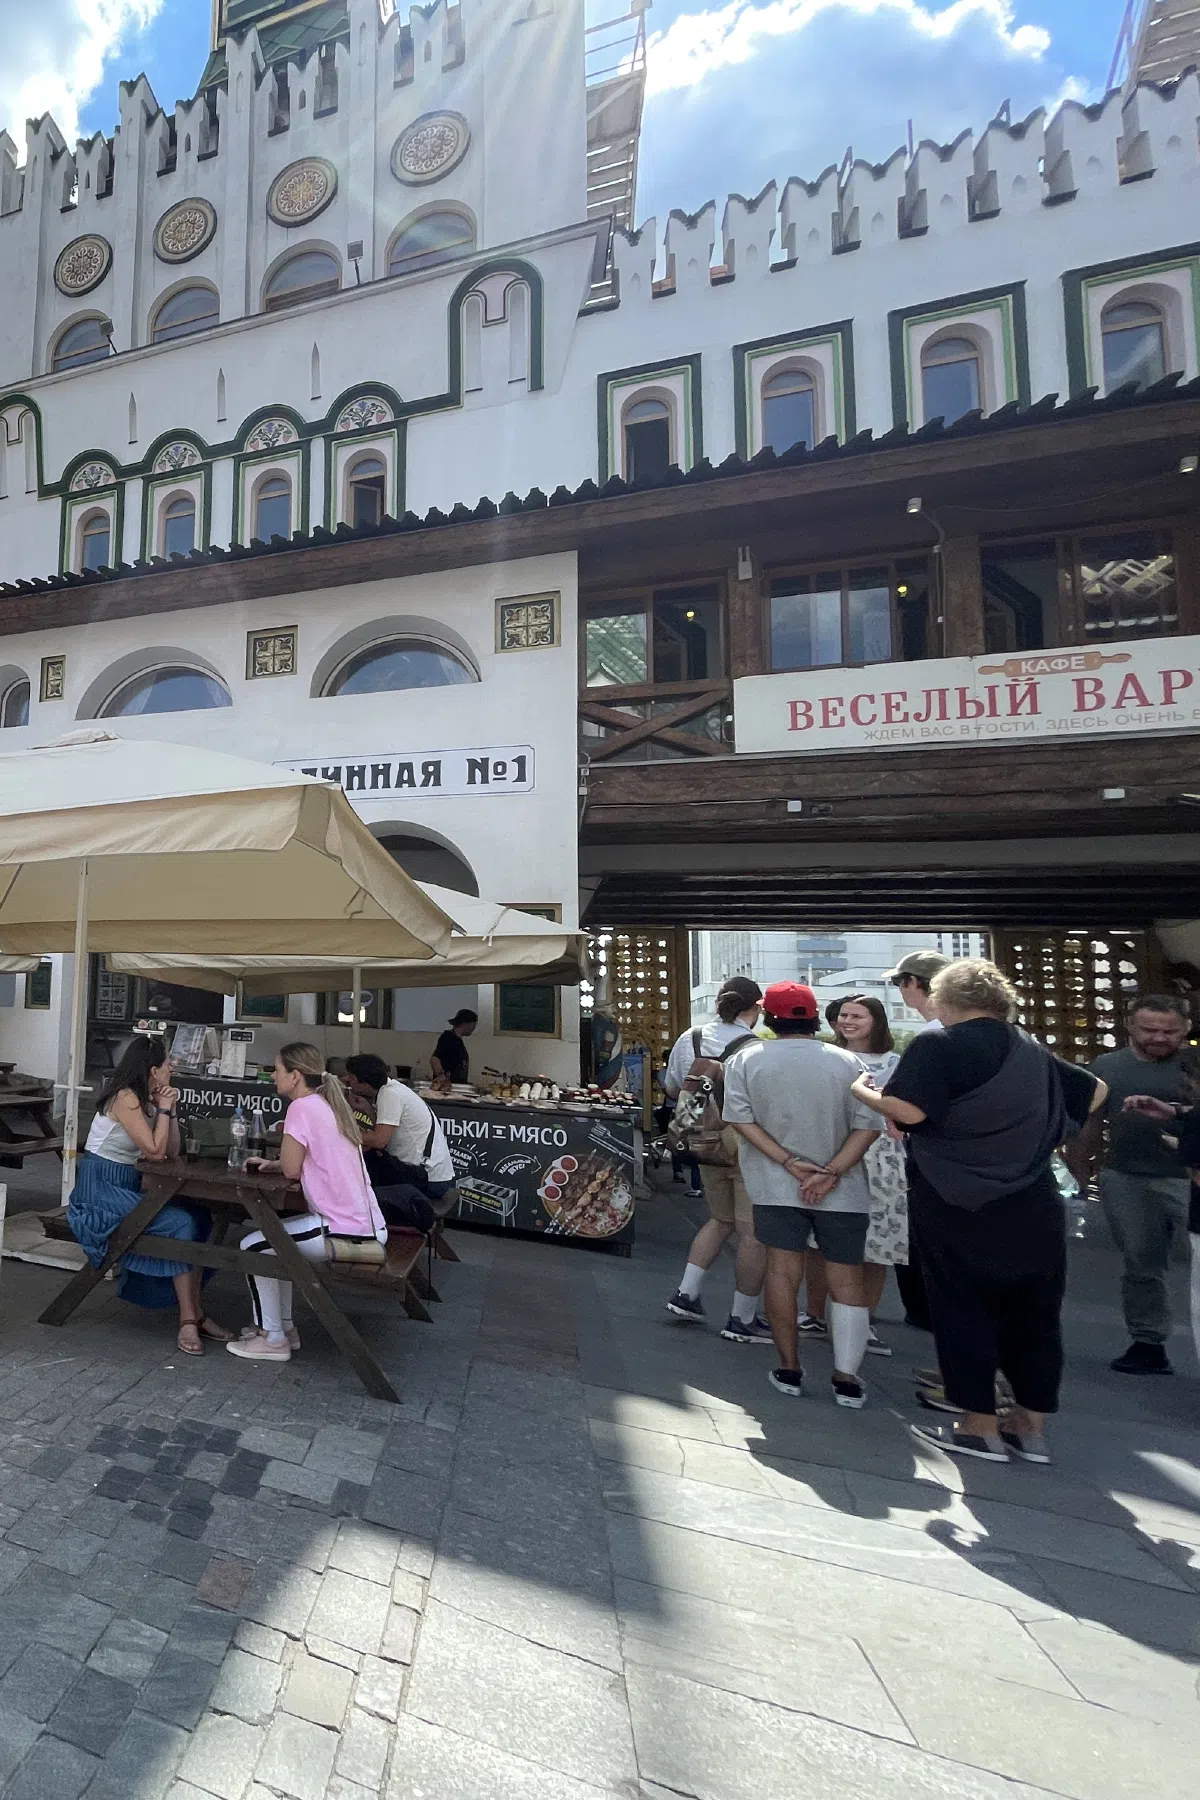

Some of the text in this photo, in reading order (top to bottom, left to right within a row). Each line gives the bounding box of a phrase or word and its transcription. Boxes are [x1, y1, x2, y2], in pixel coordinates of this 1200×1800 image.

[1020, 655, 1086, 675] КАФЕ
[786, 668, 1200, 732] ВЕСЕЛЫЙ ВАР
[863, 728, 915, 741] ЖДЕМ
[920, 724, 955, 738] ВАС
[960, 724, 970, 735] В
[1045, 715, 1109, 731] ЗДЕСЬ
[1115, 710, 1185, 726] ОЧЕНЬ
[466, 754, 527, 785] №1
[237, 1093, 282, 1113] МЯСО
[440, 1117, 568, 1147] ЛЬКИ МЯСО
